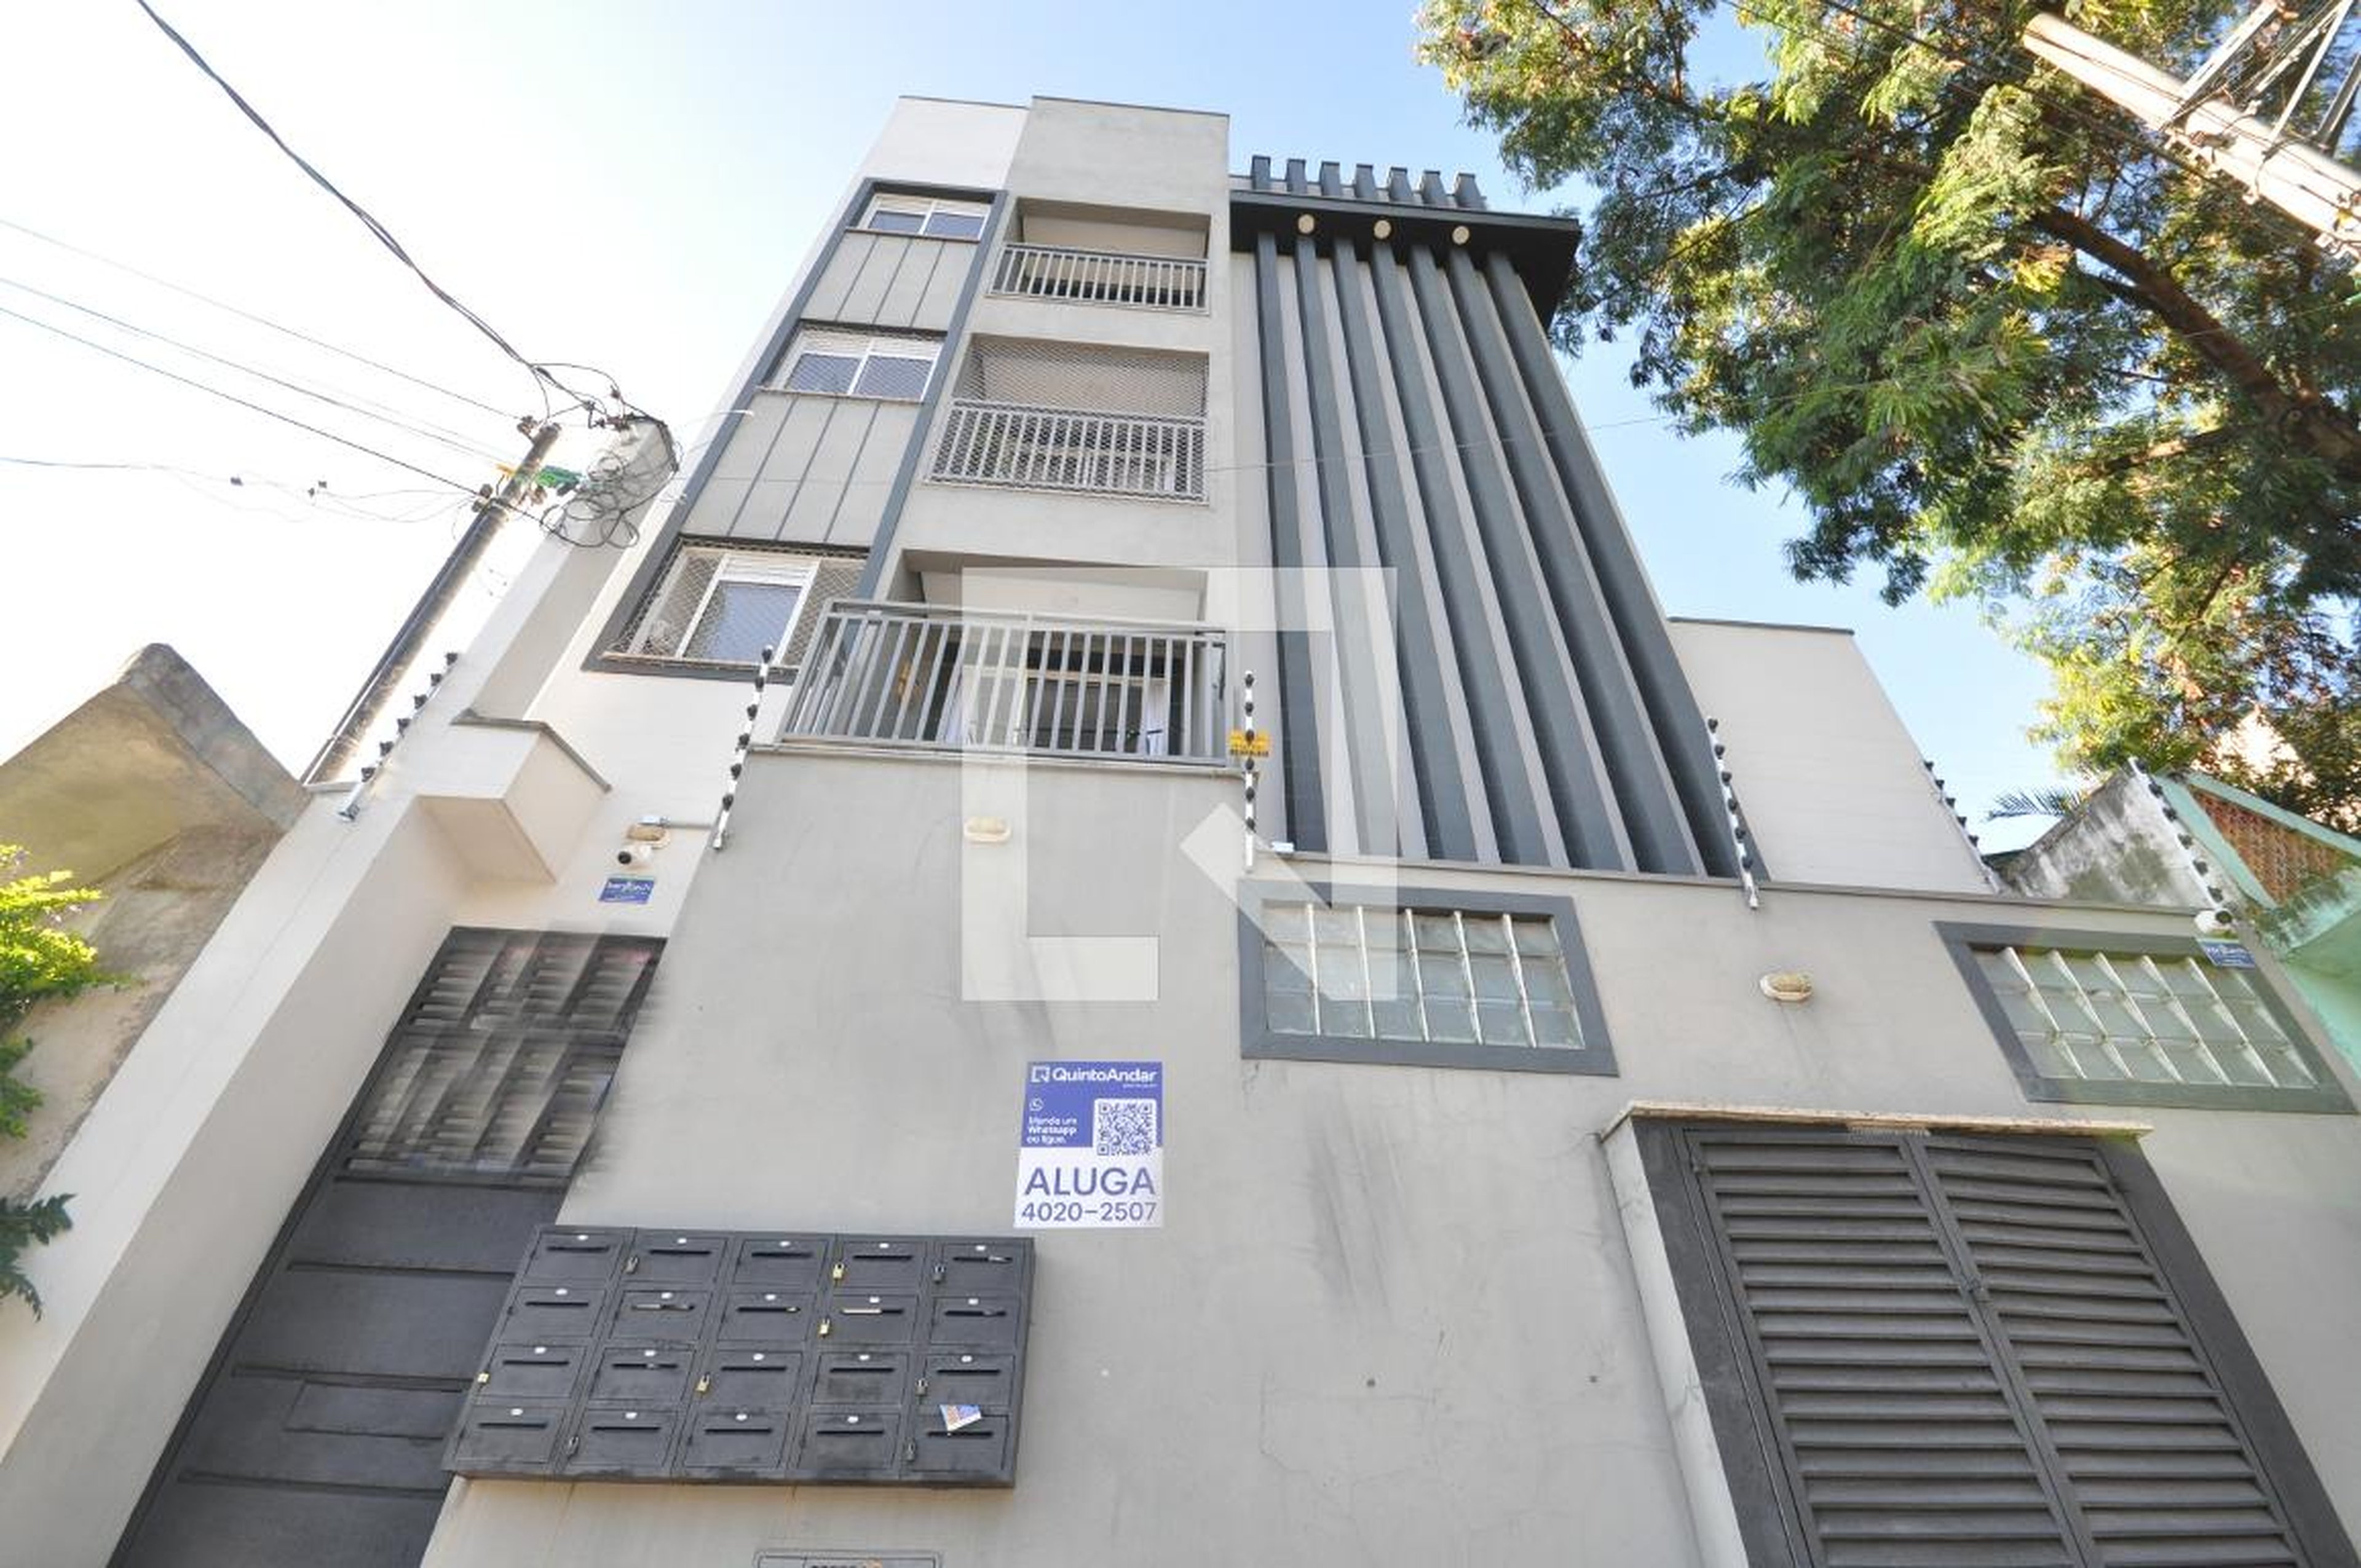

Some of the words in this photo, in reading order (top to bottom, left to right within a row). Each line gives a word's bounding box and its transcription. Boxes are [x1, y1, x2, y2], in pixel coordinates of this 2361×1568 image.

[1052, 1067, 1157, 1082] QuintoAndar
[1024, 1167, 1156, 1196] ALUGA
[1021, 1202, 1157, 1222] 4020-2507
